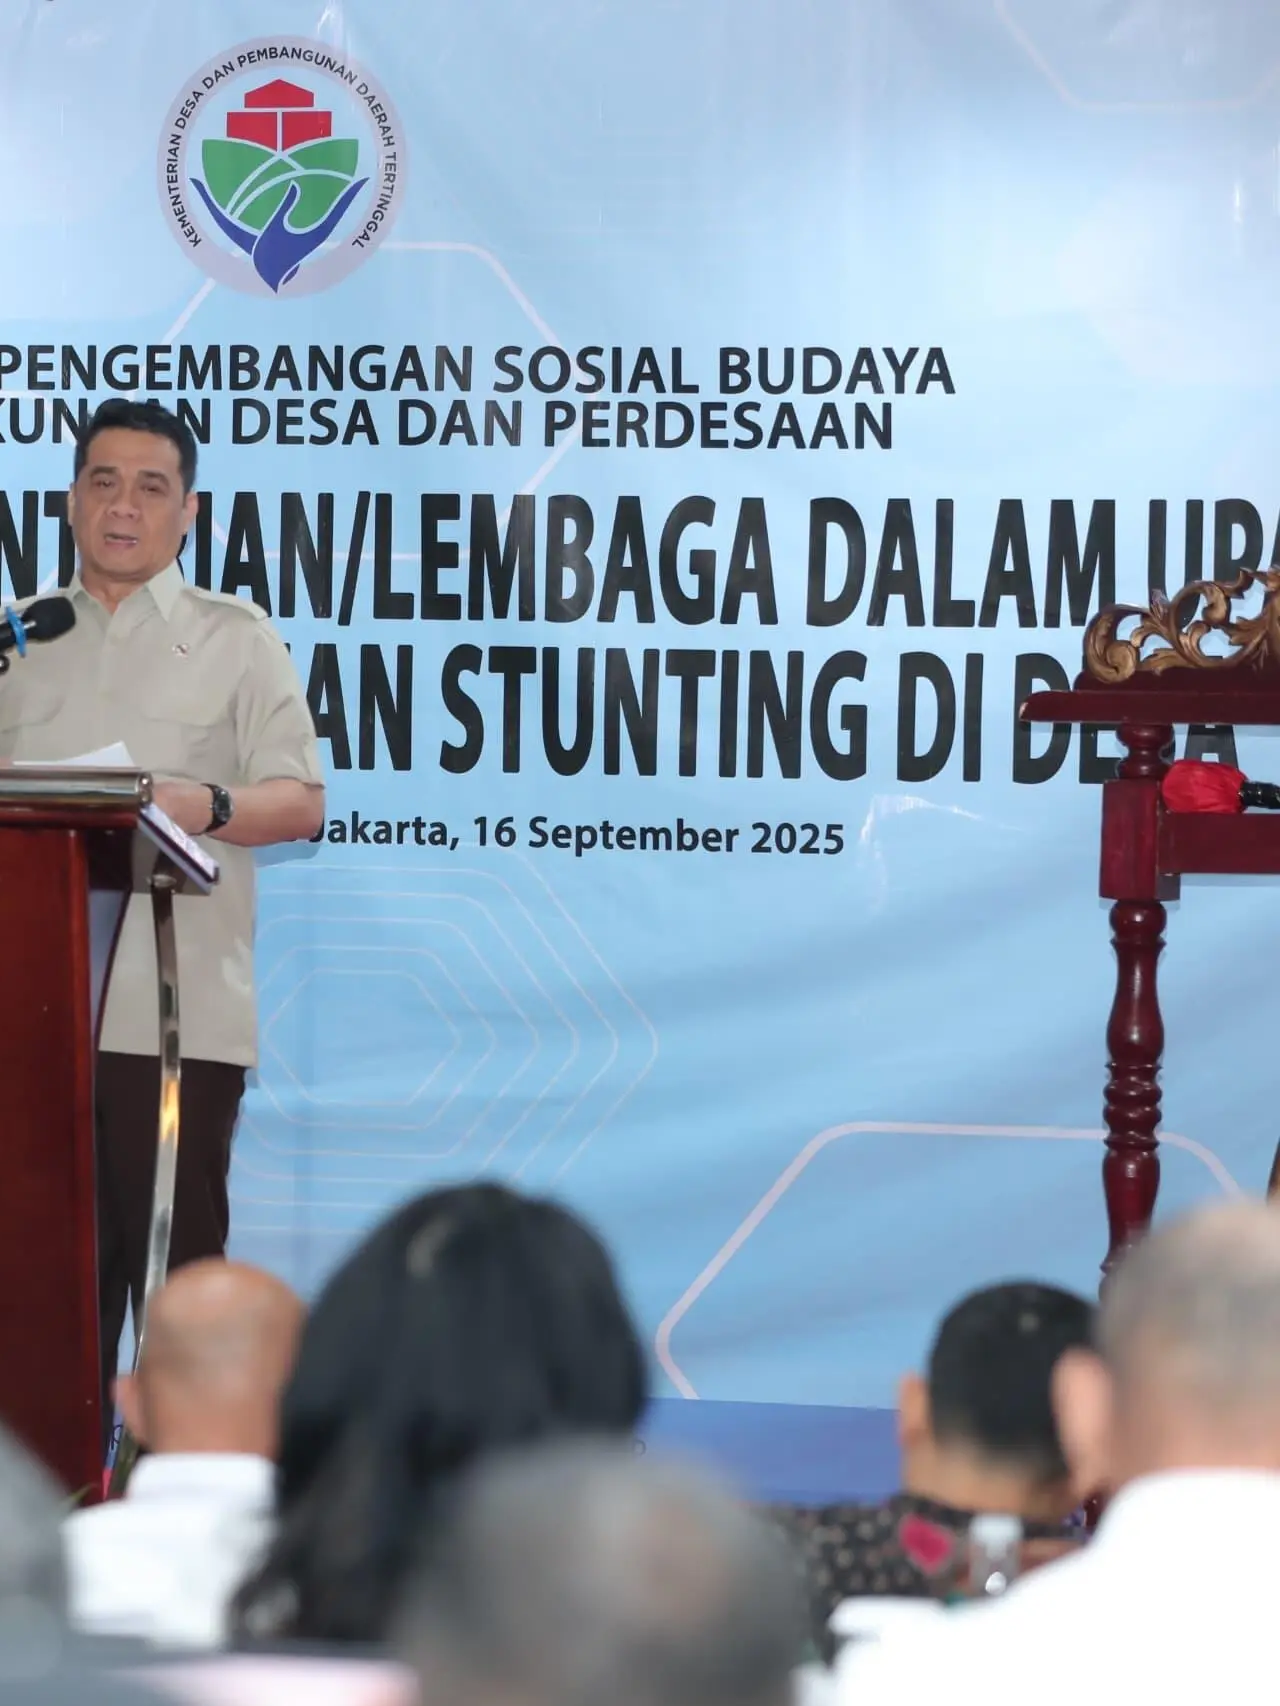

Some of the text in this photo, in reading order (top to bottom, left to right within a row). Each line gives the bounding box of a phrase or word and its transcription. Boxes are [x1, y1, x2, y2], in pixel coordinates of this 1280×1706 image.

[166, 46, 397, 249] KEMENTERIAN DESA DAN PEMBANGUNAN DAERAH TERTINGGAL
[493, 345, 699, 394] SOSIAL
[719, 346, 956, 395] BUDAYA
[231, 398, 380, 446] DESA
[398, 398, 522, 447] DAN
[544, 400, 892, 450] PERDESAAN
[806, 497, 1117, 629] DALAM
[439, 643, 868, 781] STUNTING
[896, 651, 984, 783] DI
[474, 817, 517, 848] 16
[528, 816, 740, 858] September
[750, 822, 844, 855] 2025
